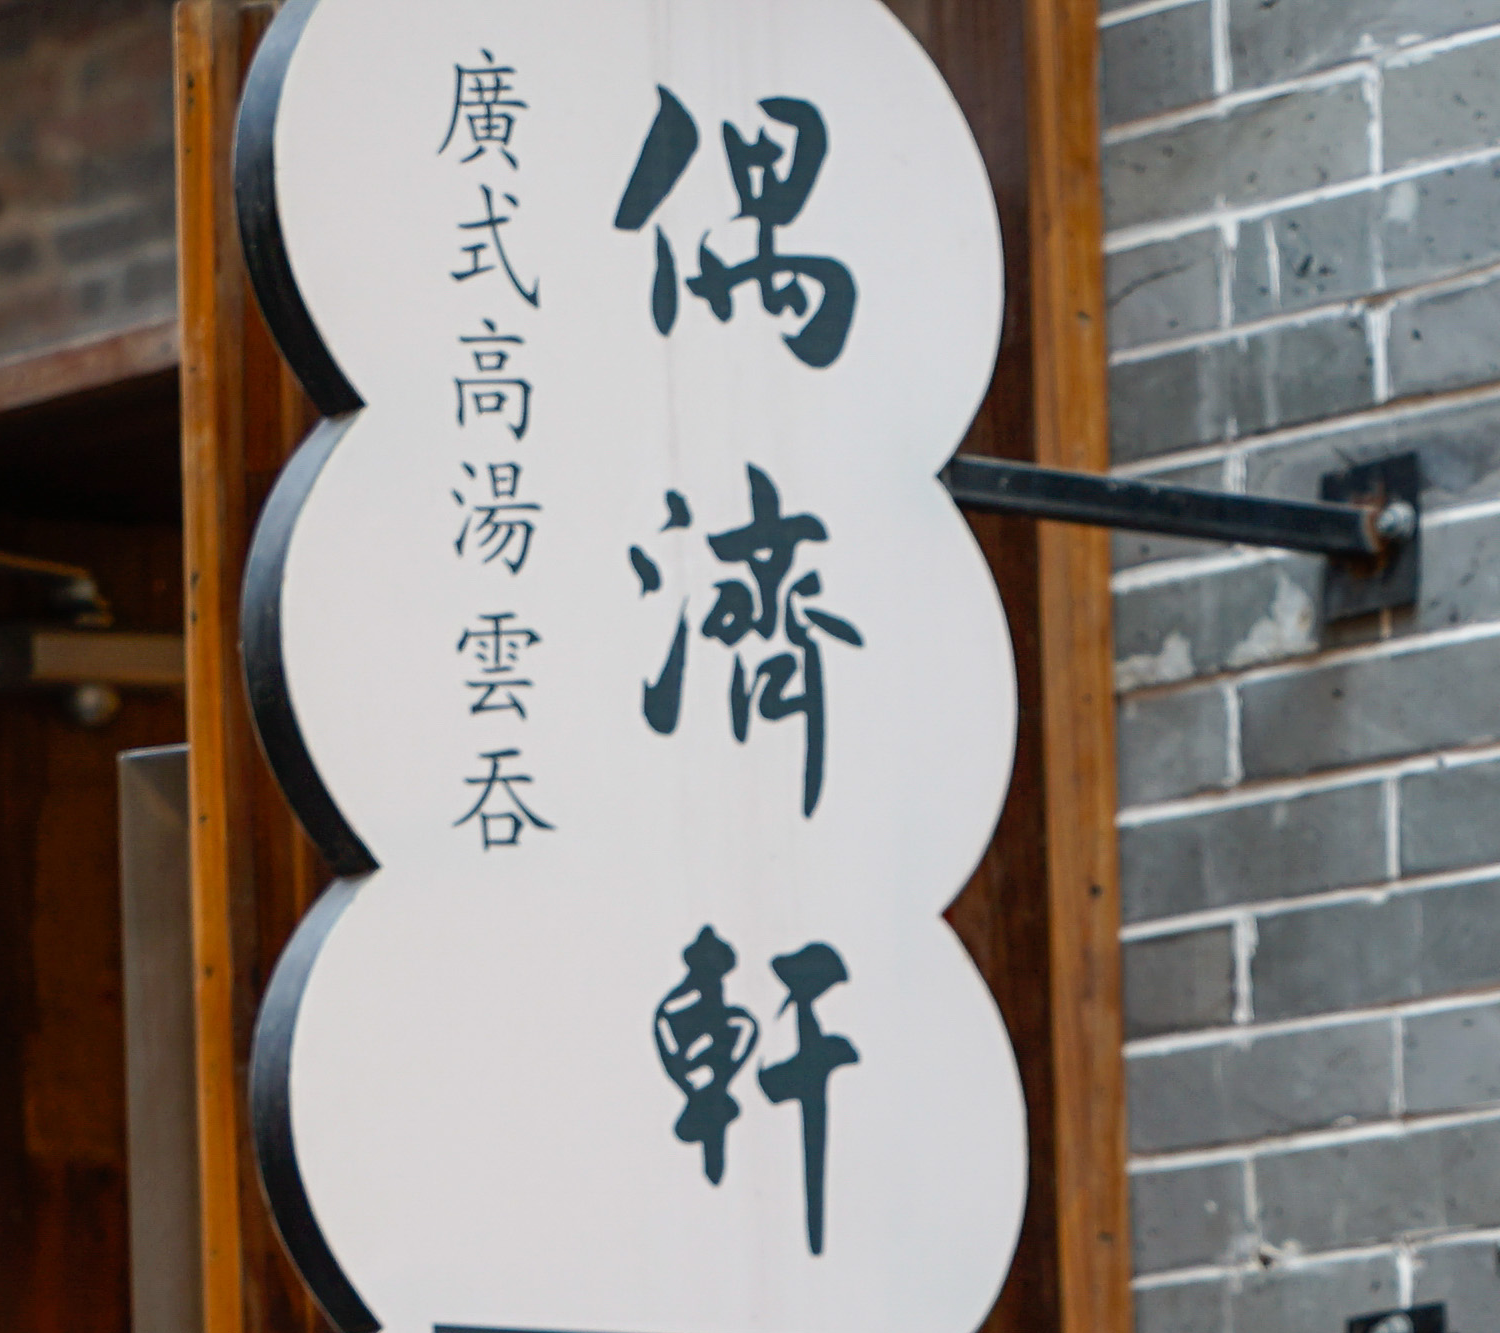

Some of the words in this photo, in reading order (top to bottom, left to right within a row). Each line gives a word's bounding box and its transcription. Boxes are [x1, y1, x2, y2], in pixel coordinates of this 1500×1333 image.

[437, 48, 557, 853] 廣式高湯雲吞
[613, 83, 864, 1256] 偶濟軒
